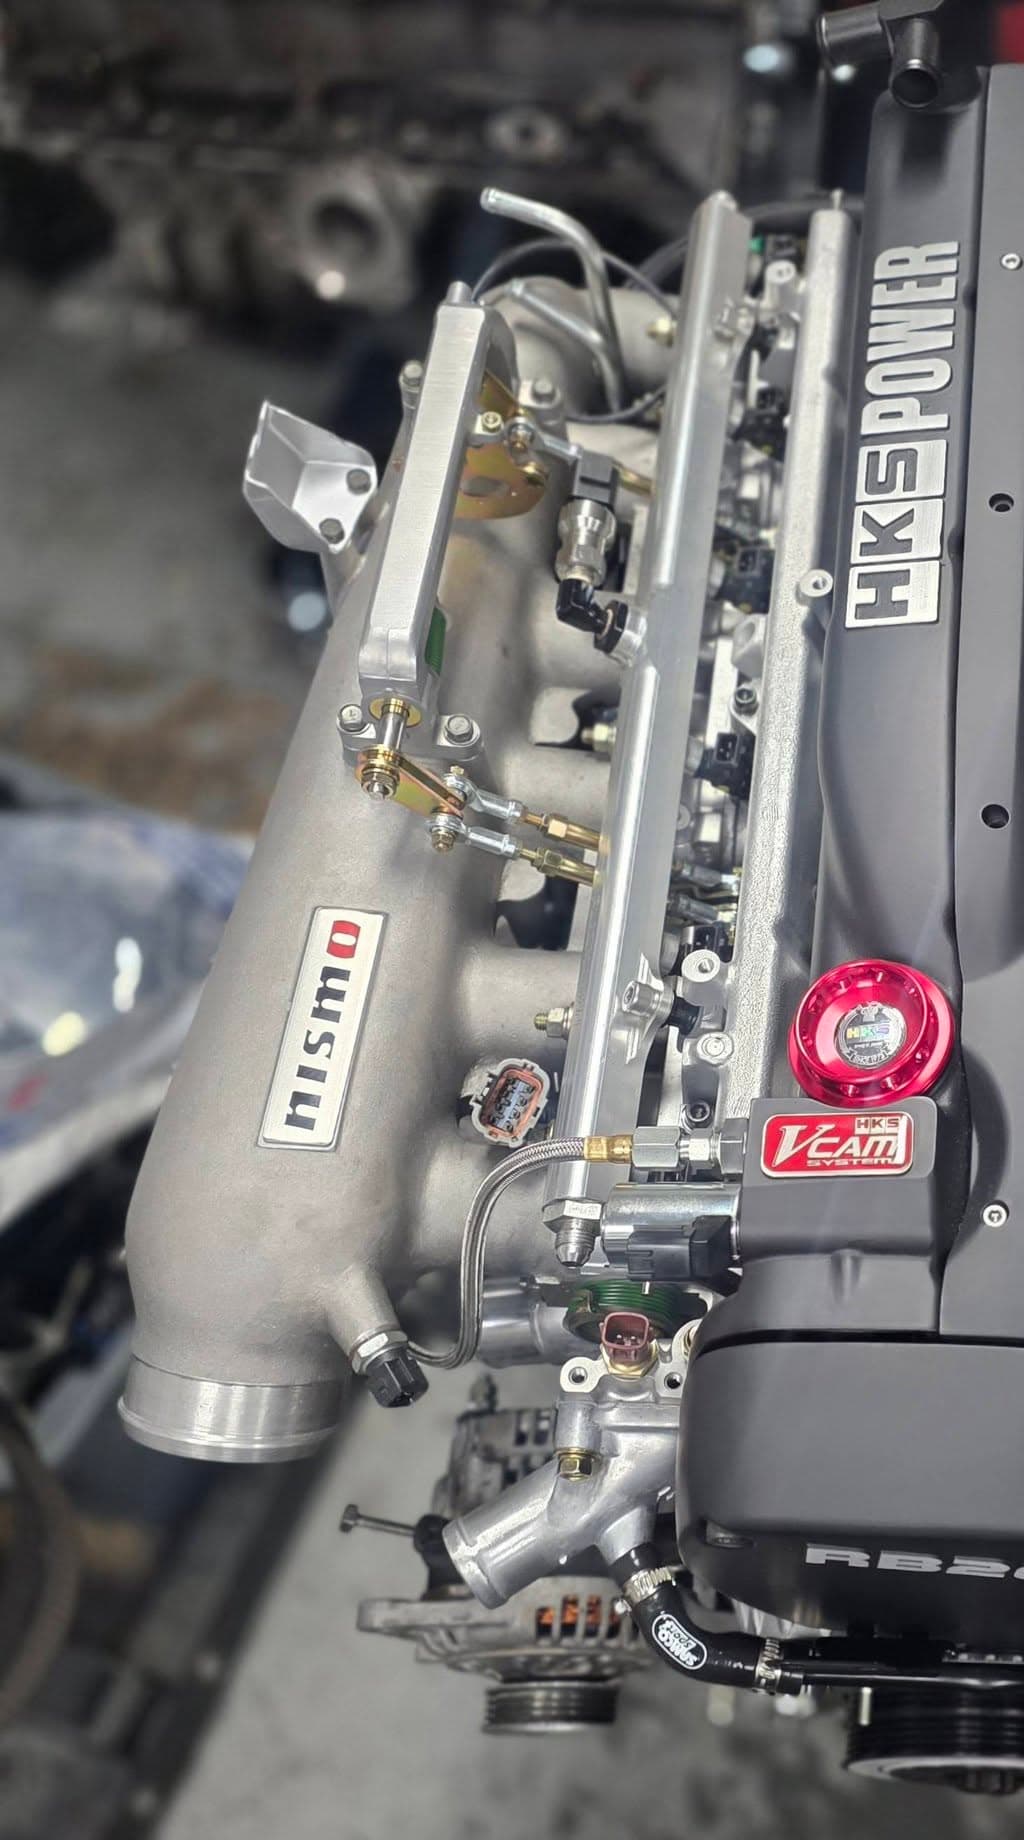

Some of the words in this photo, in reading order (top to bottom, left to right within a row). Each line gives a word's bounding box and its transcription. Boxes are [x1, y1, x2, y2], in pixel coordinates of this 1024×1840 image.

[860, 241, 959, 435] POWER
[845, 440, 941, 627] HKS
[285, 920, 361, 1131] nismo
[846, 1023, 890, 1040] HKS
[807, 1157, 894, 1167] SYSTEM
[855, 1117, 900, 1132] HKS
